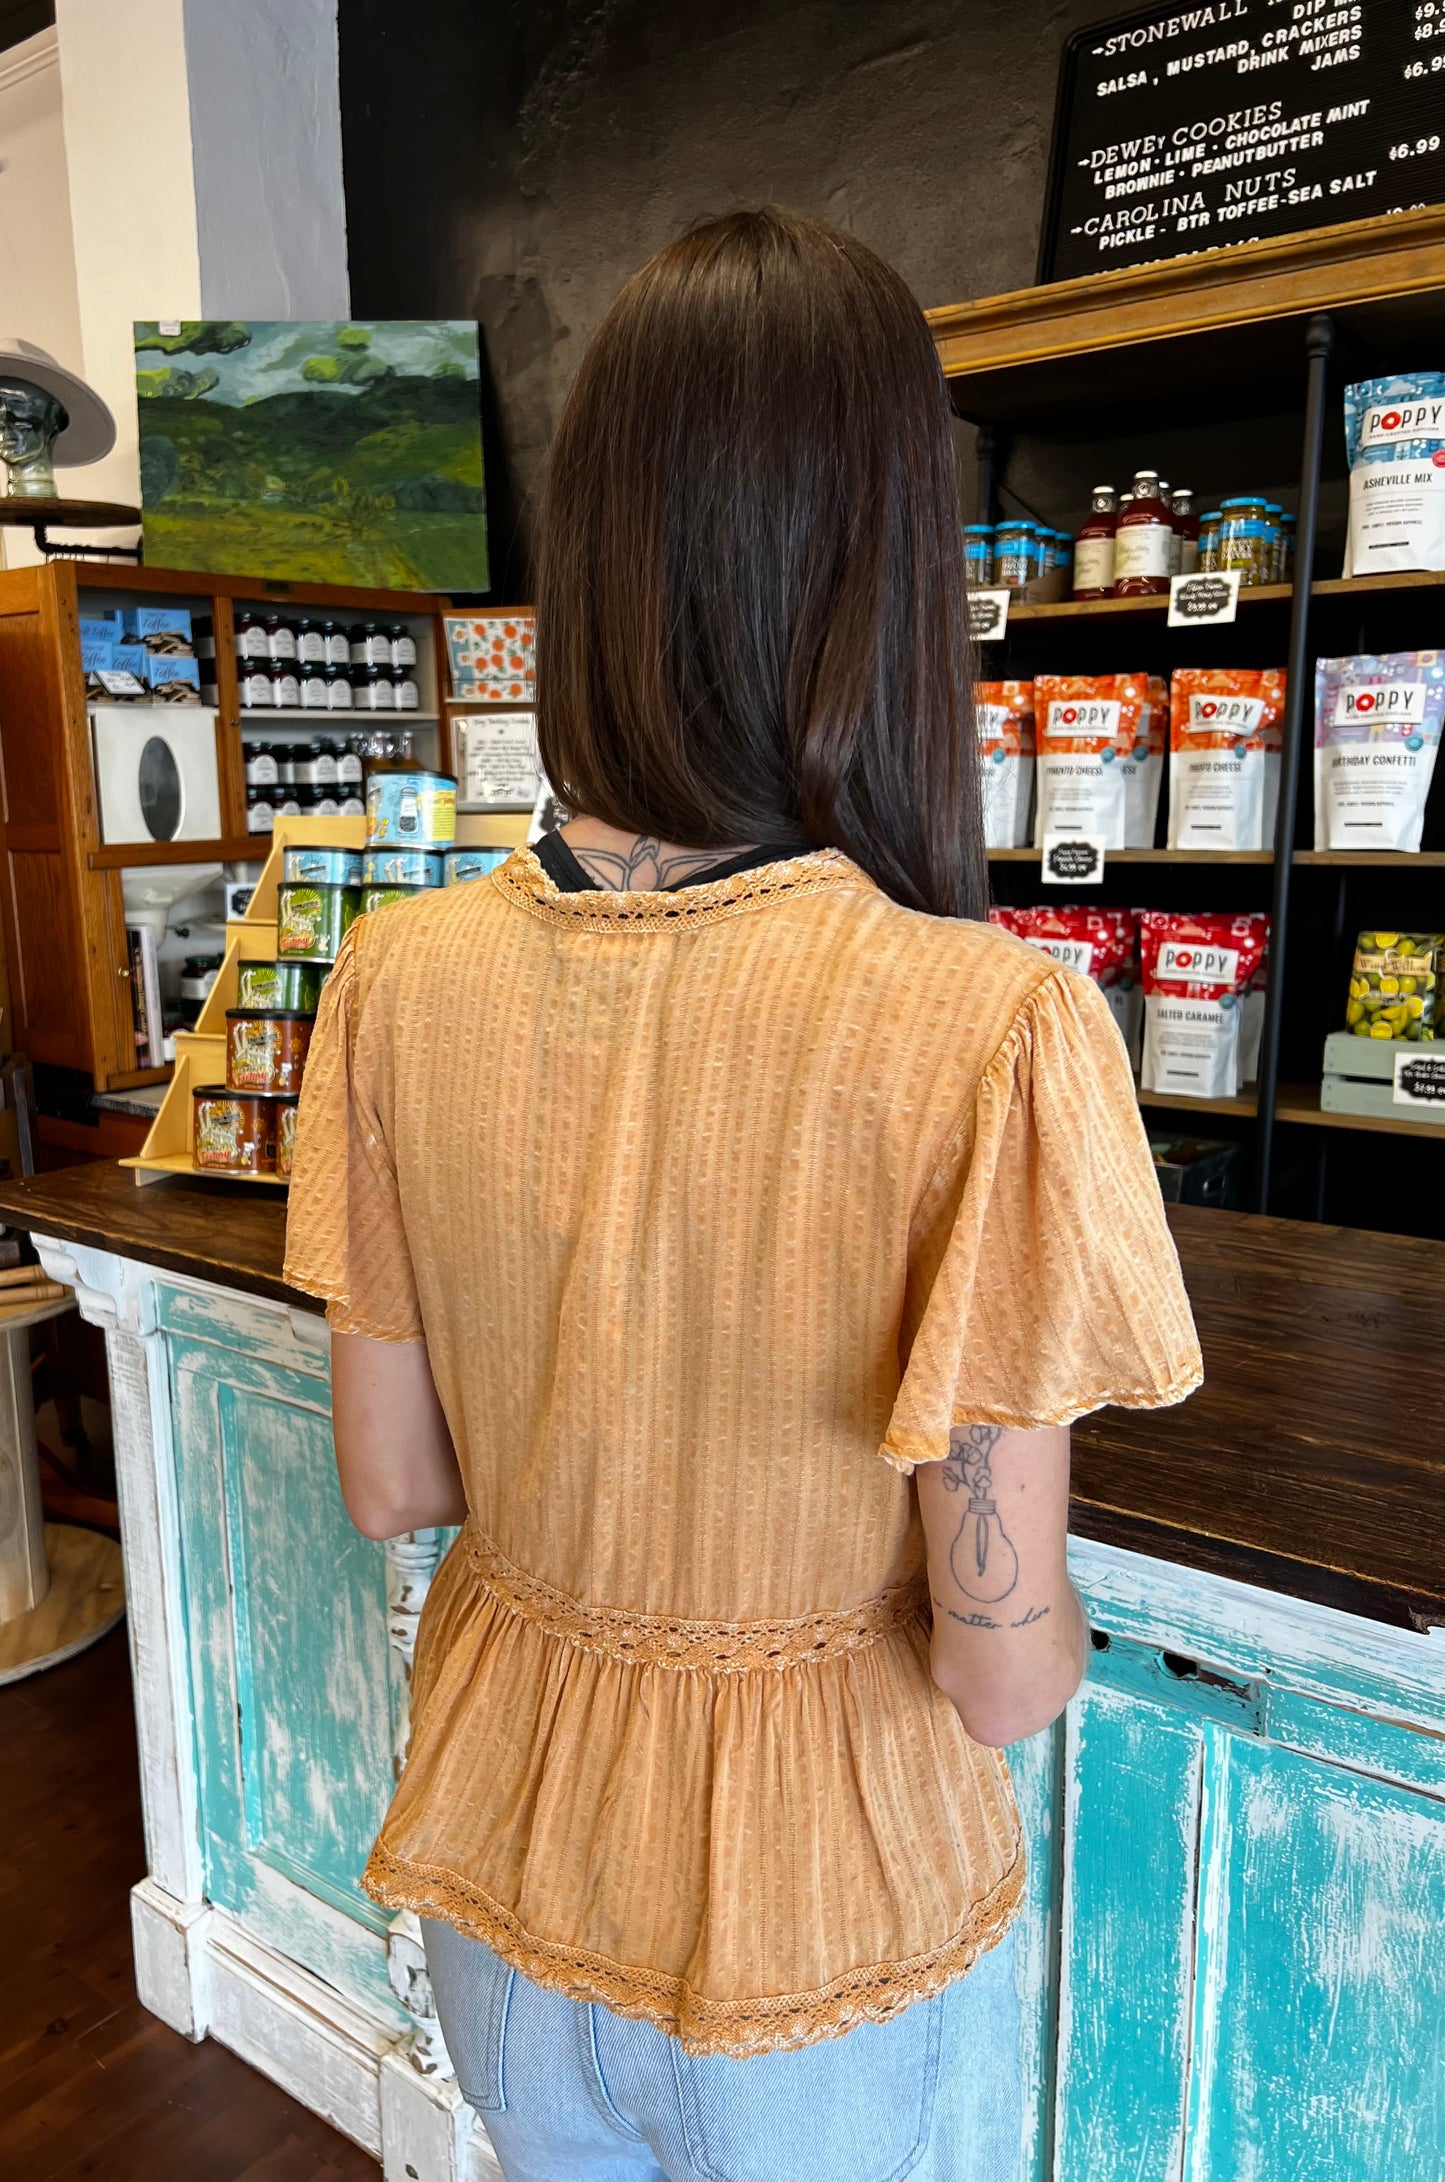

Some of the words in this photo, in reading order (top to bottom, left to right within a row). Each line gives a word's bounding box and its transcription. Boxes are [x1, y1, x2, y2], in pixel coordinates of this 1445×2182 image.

[1292, 0, 1326, 20] DIP
[1104, 0, 1248, 56] STONEWALL
[1261, 6, 1362, 47] CRACKERS
[1237, 46, 1289, 74] DRINK
[1298, 24, 1363, 56] MIXERS
[1311, 45, 1361, 71] JAMS
[1172, 101, 1282, 146] COOKIES
[1094, 158, 1151, 185] LEMON
[1164, 143, 1206, 167] LIME
[1224, 112, 1322, 150] CHOCOLATE
[1326, 99, 1371, 124] MINT
[1191, 131, 1324, 178] PEANUTBUTTER
[1389, 135, 1441, 161] $6.99
[1083, 191, 1206, 236] CAROLINA
[1224, 168, 1297, 202] NUTS
[1176, 211, 1211, 232] BTR
[1329, 170, 1378, 195] SALT
[1370, 404, 1443, 433] POPPY
[1363, 474, 1412, 490] ASHEVILLE
[1414, 472, 1433, 484] MIX
[1195, 701, 1254, 722] POPPY
[1346, 690, 1414, 713] POPPY
[1053, 707, 1111, 726] POPPY
[1373, 754, 1417, 767] CONFETTI
[1166, 950, 1228, 973] POPPY
[1157, 1008, 1184, 1021] SALTED
[1185, 1010, 1225, 1024] CARAMEL
[948, 1610, 1003, 1629] matter
